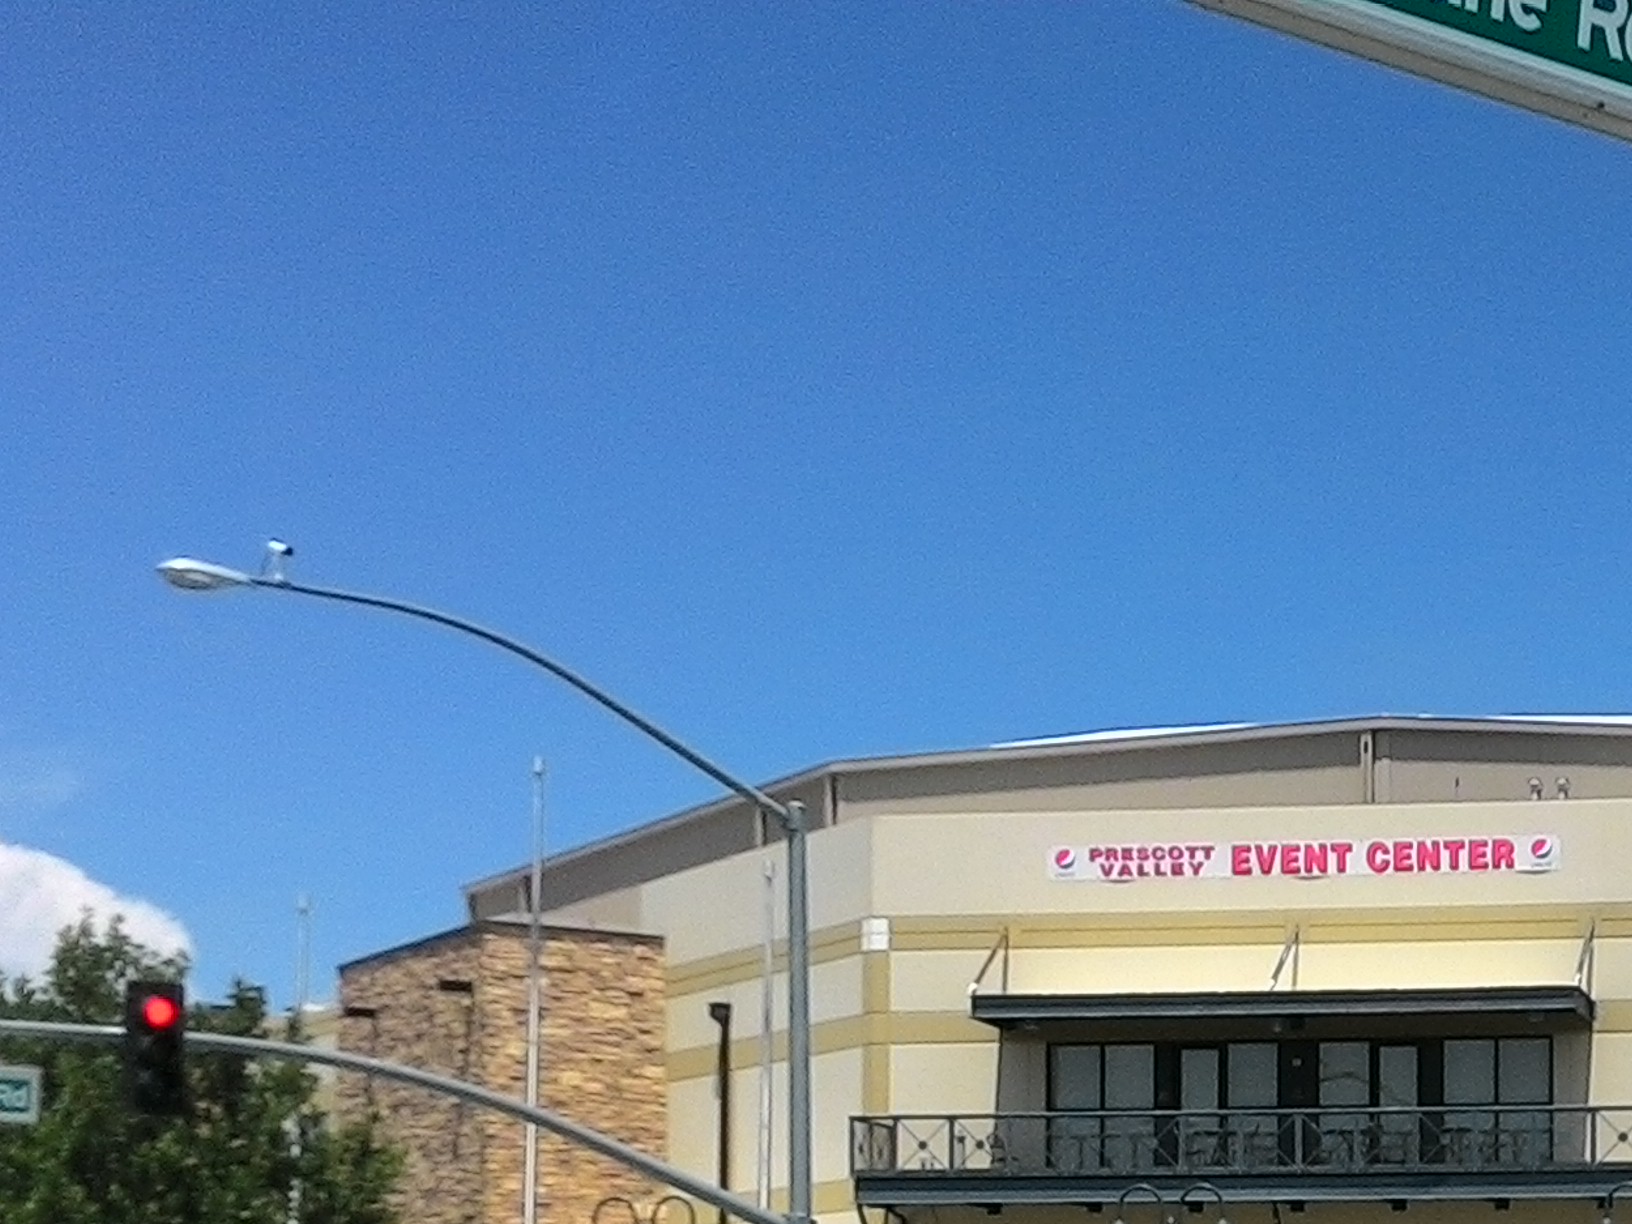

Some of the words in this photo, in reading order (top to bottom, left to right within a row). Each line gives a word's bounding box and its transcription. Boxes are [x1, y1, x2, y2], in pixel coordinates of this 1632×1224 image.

[1088, 845, 1216, 862] PRESCOTT
[1231, 843, 1354, 876] EVENT
[1366, 838, 1516, 873] CENTER
[1101, 861, 1205, 877] VALLEY
